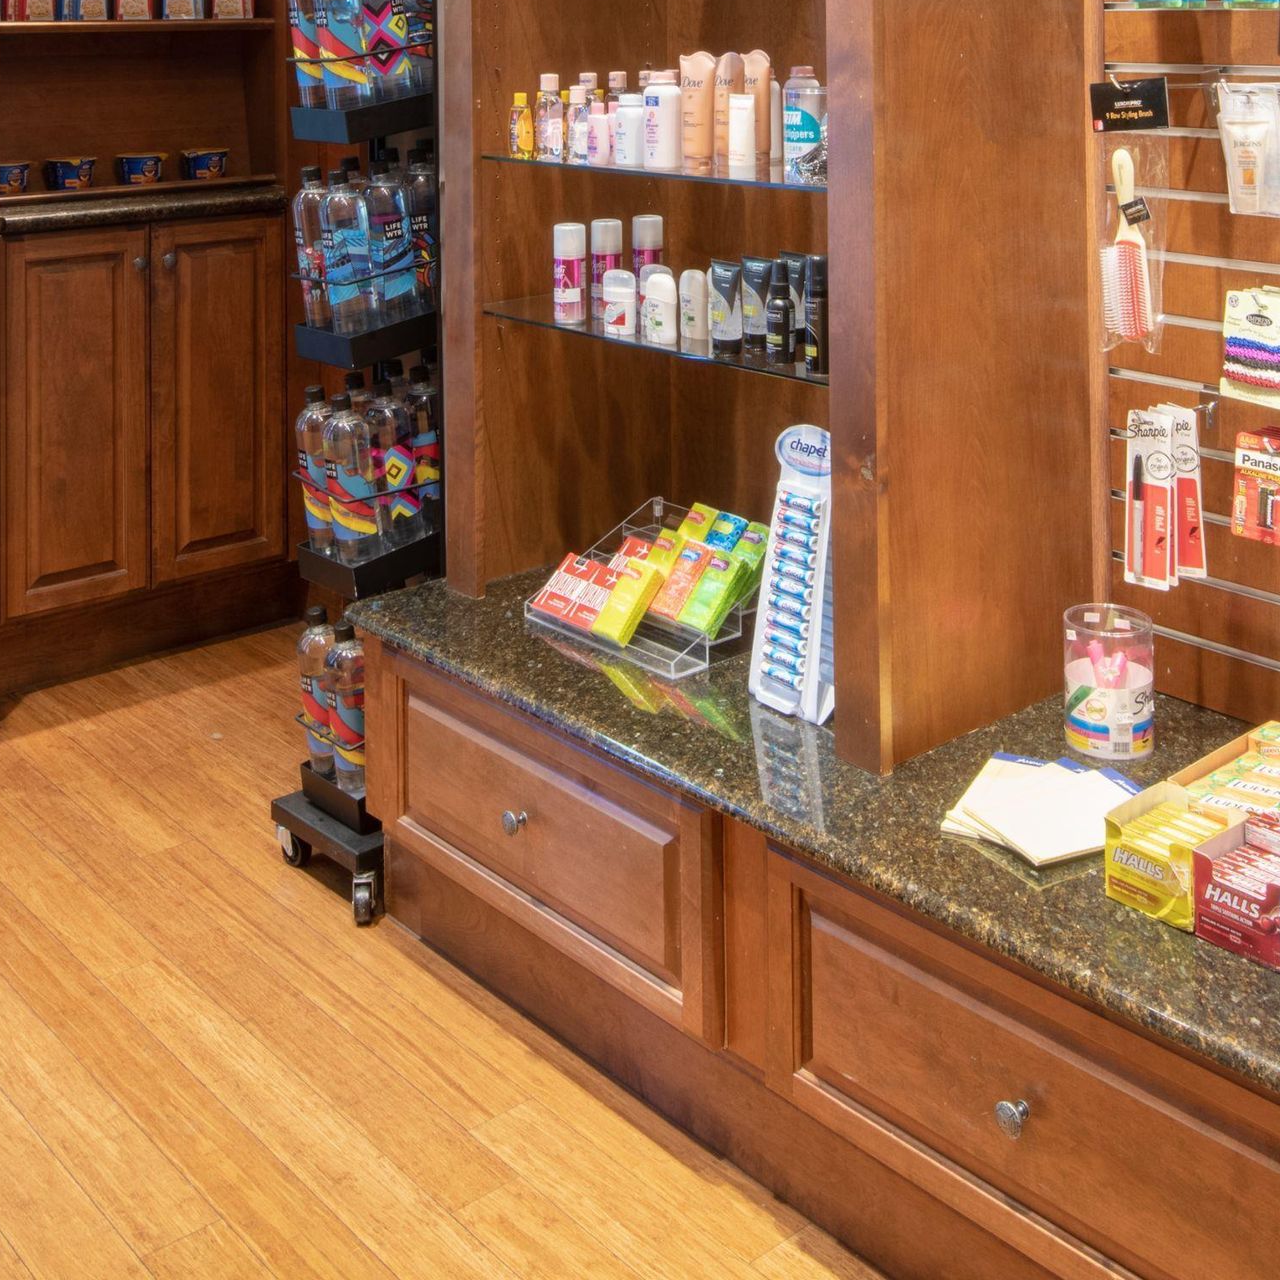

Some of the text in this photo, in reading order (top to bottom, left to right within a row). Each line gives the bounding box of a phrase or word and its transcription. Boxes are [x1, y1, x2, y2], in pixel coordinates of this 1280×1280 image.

[682, 76, 703, 88] Dove
[715, 77, 734, 86] Dove
[411, 216, 427, 224] LIFE
[385, 222, 401, 230] LIFE
[412, 223, 428, 231] WTR
[386, 230, 402, 238] WTR
[1128, 424, 1168, 439] Sharpie
[1113, 848, 1164, 881] HALLS
[1204, 883, 1260, 918] HALLS
